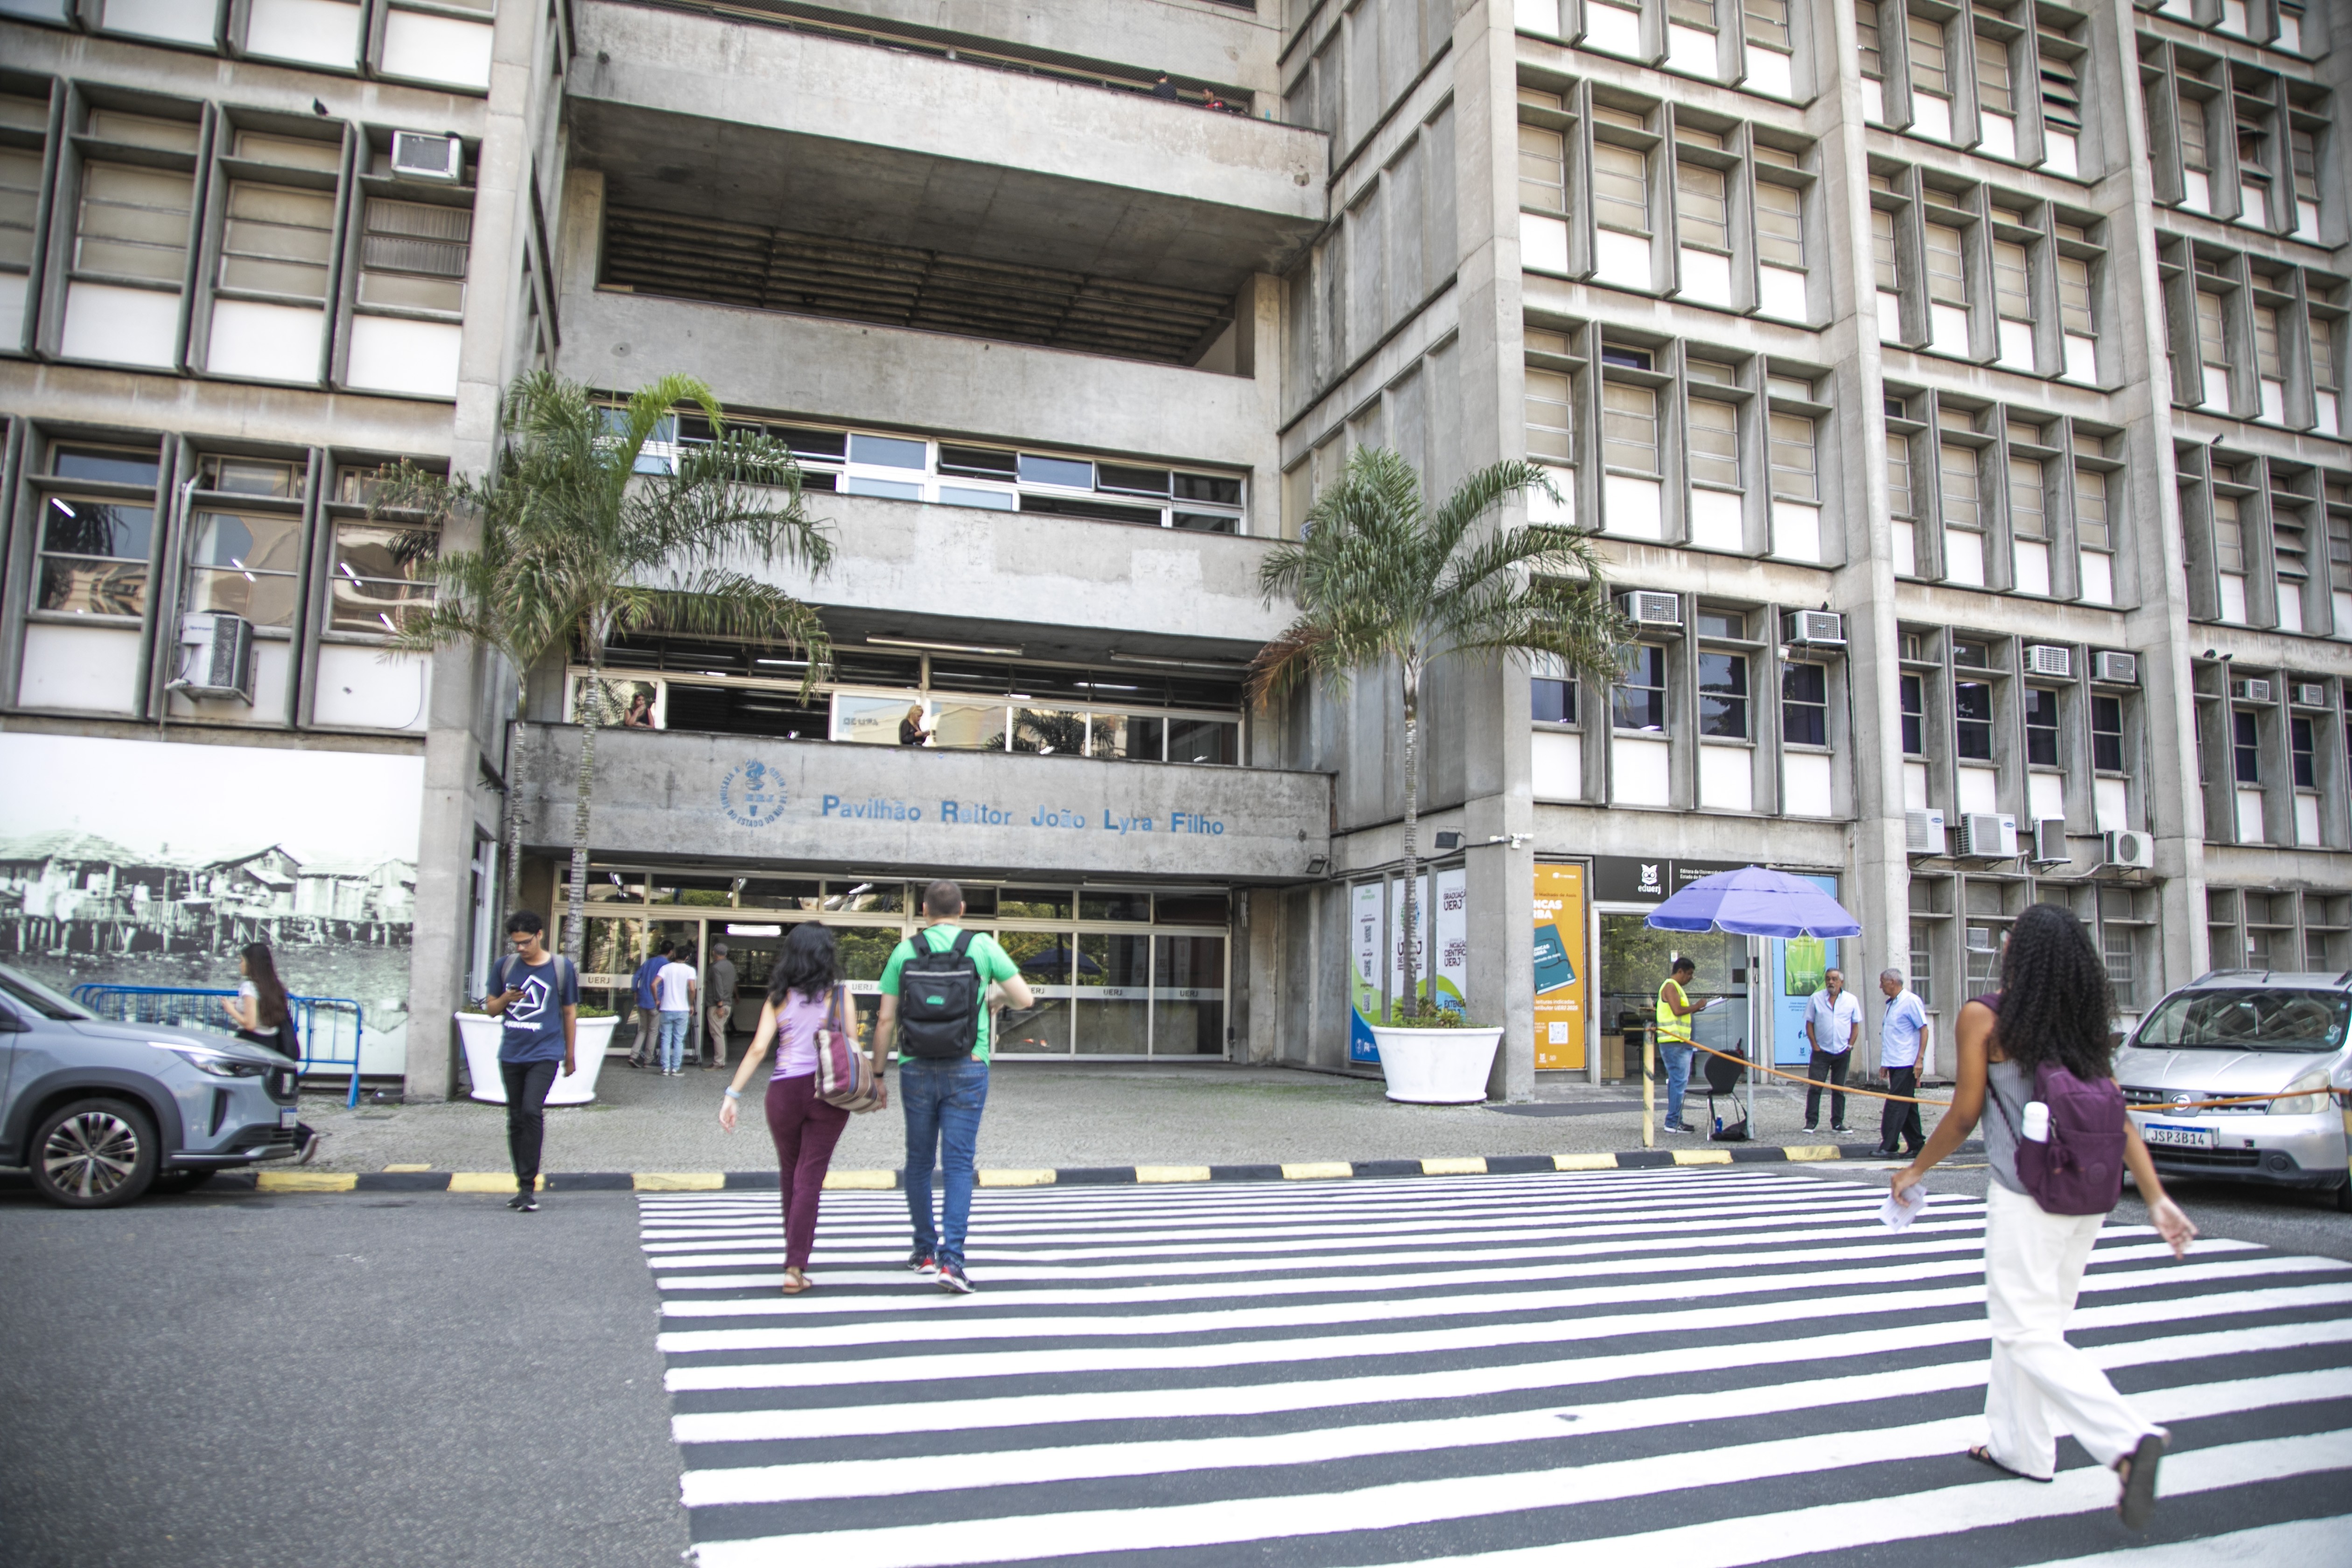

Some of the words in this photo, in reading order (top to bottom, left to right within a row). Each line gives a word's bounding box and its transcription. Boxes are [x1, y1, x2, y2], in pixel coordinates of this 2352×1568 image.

[727, 809, 737, 819] DO
[736, 816, 763, 827] ESTADO
[764, 814, 775, 824] DO
[822, 794, 921, 821] Pavilhão
[941, 800, 1012, 825] Reitor
[1030, 805, 1085, 828] João
[1104, 809, 1153, 834] Lyra
[1171, 812, 1224, 834] Filho
[1638, 884, 1661, 895] eduerj
[1443, 899, 1462, 910] UERJ
[1398, 940, 1422, 956] UJ
[1444, 957, 1461, 966] UERJ
[588, 976, 610, 984] UERJ
[2151, 1130, 2204, 1145] JSP3B14
